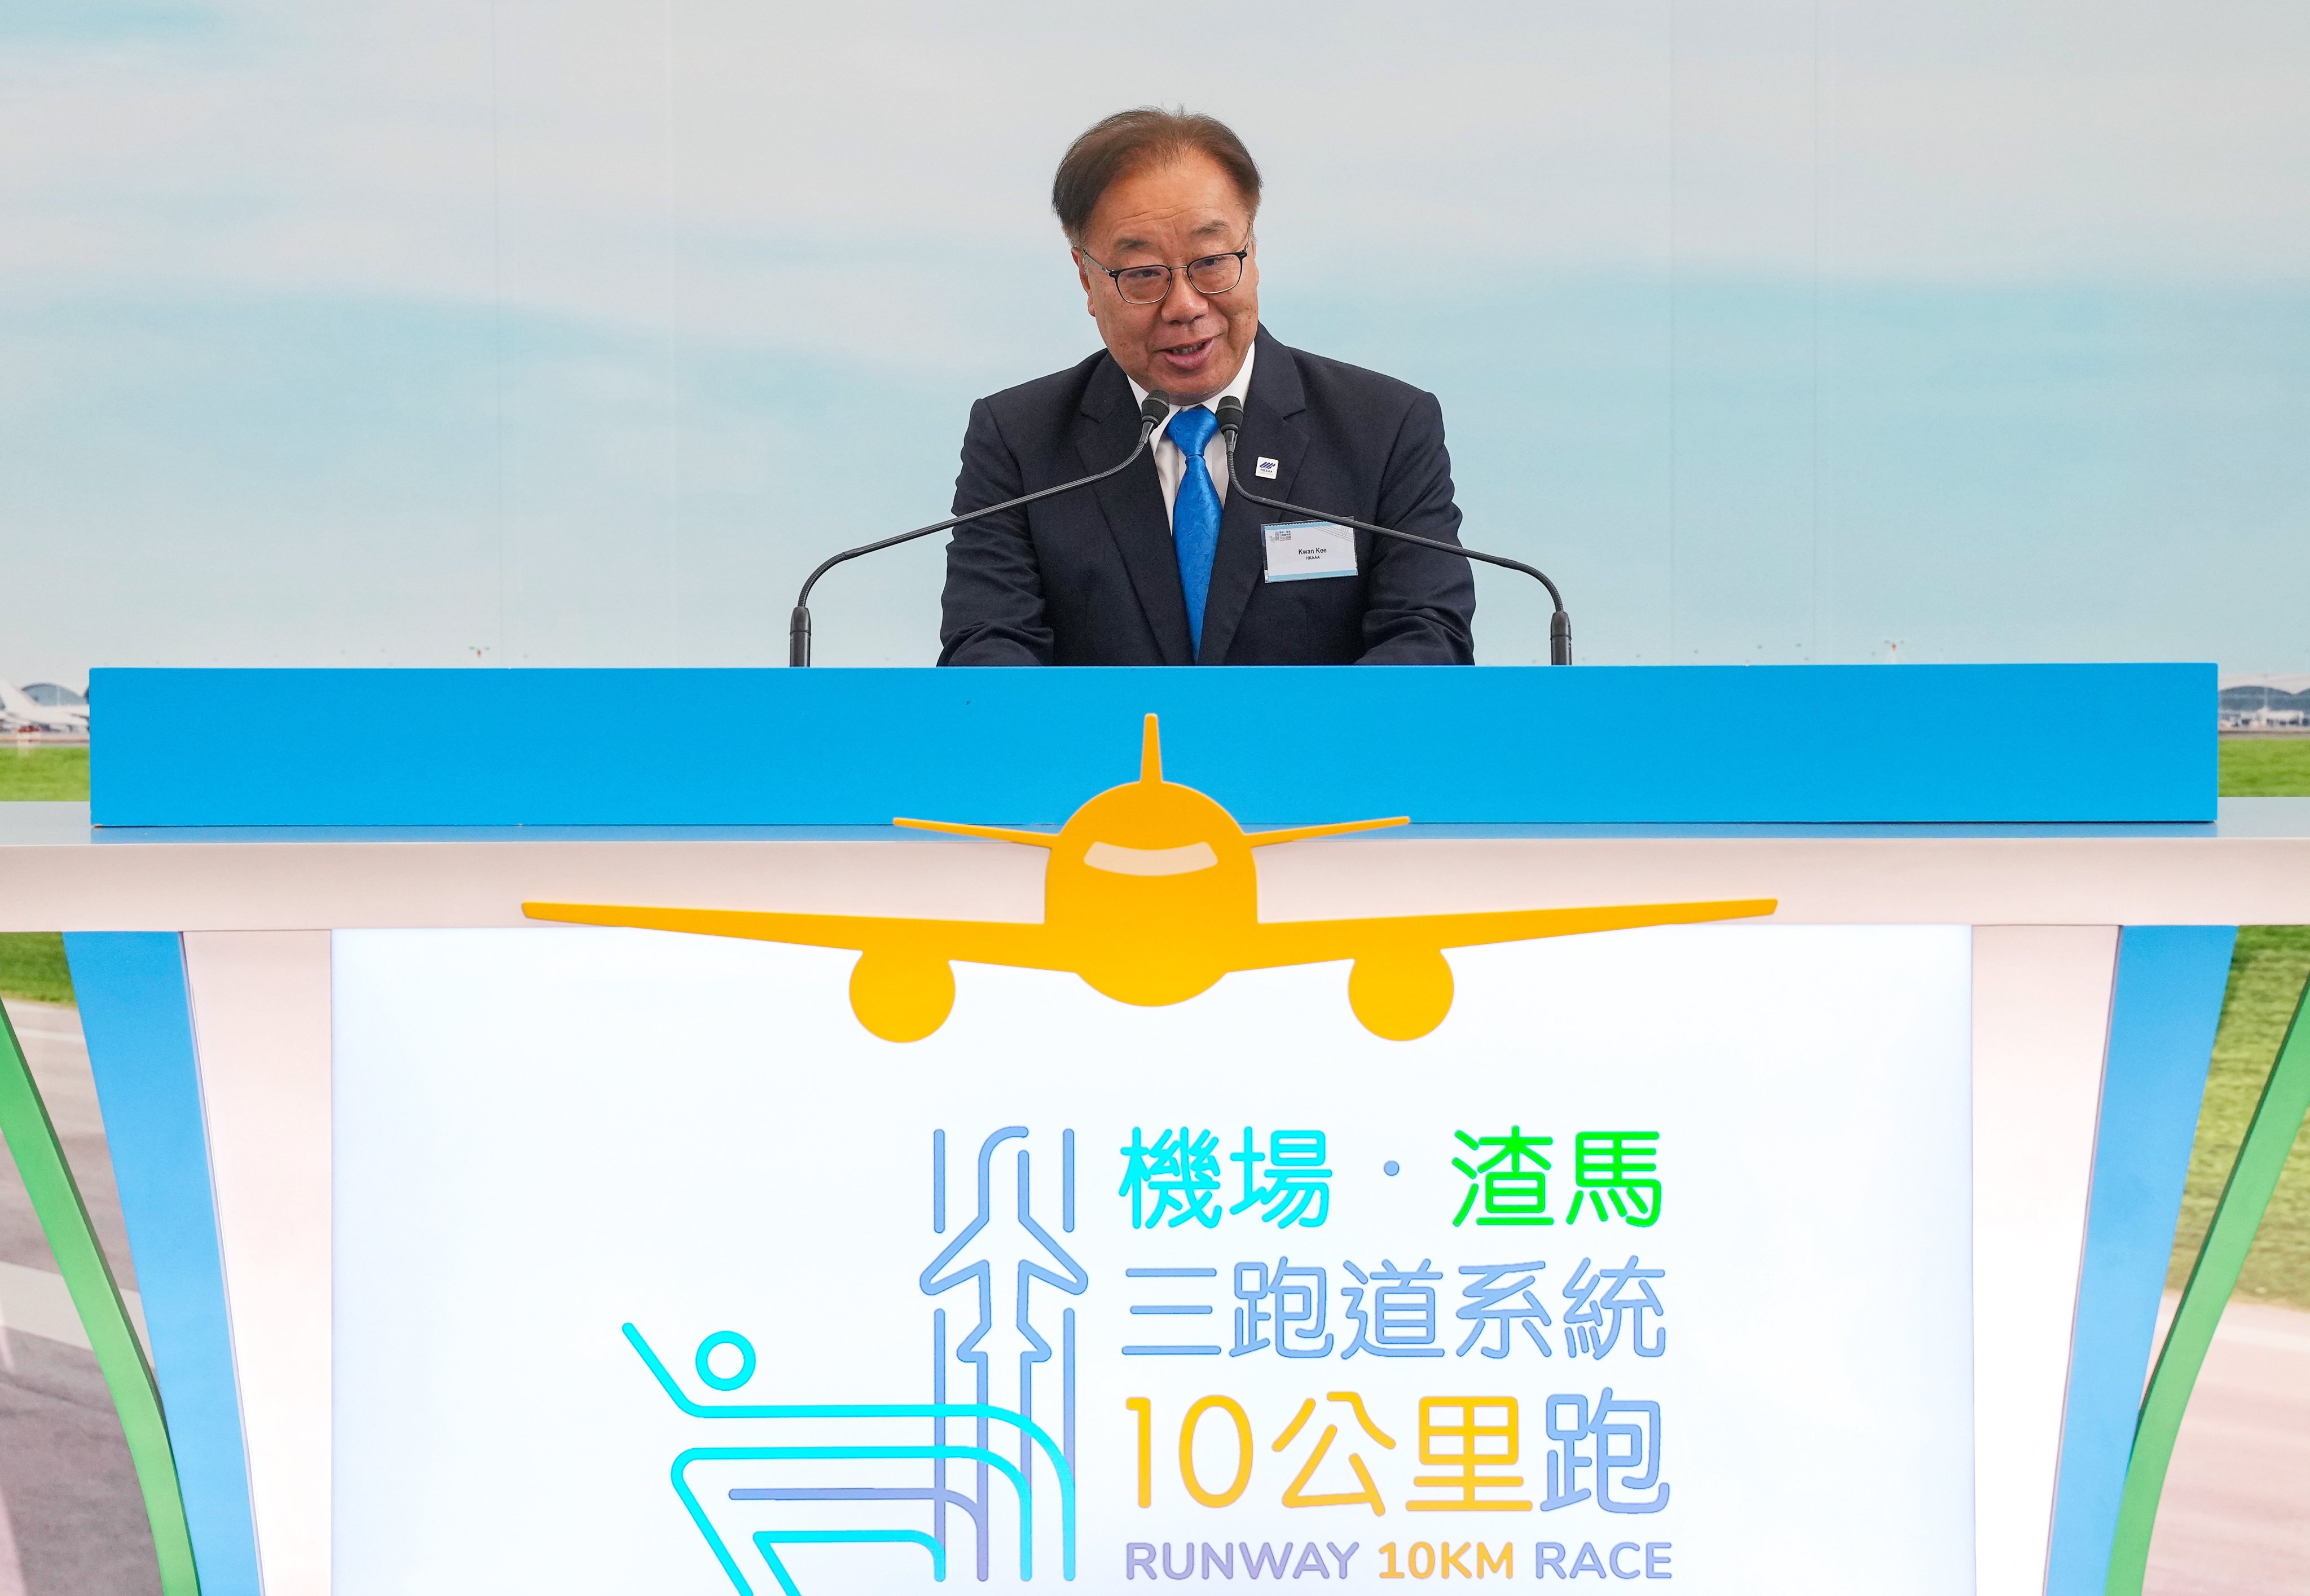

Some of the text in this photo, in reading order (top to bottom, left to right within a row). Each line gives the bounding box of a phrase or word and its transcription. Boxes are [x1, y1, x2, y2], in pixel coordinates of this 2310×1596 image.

[1121, 1255, 1666, 1361] 三跑道系統
[1126, 1387, 1670, 1516] 10公里跑
[1127, 1542, 1672, 1580] RUNWAY 10KM RACE
